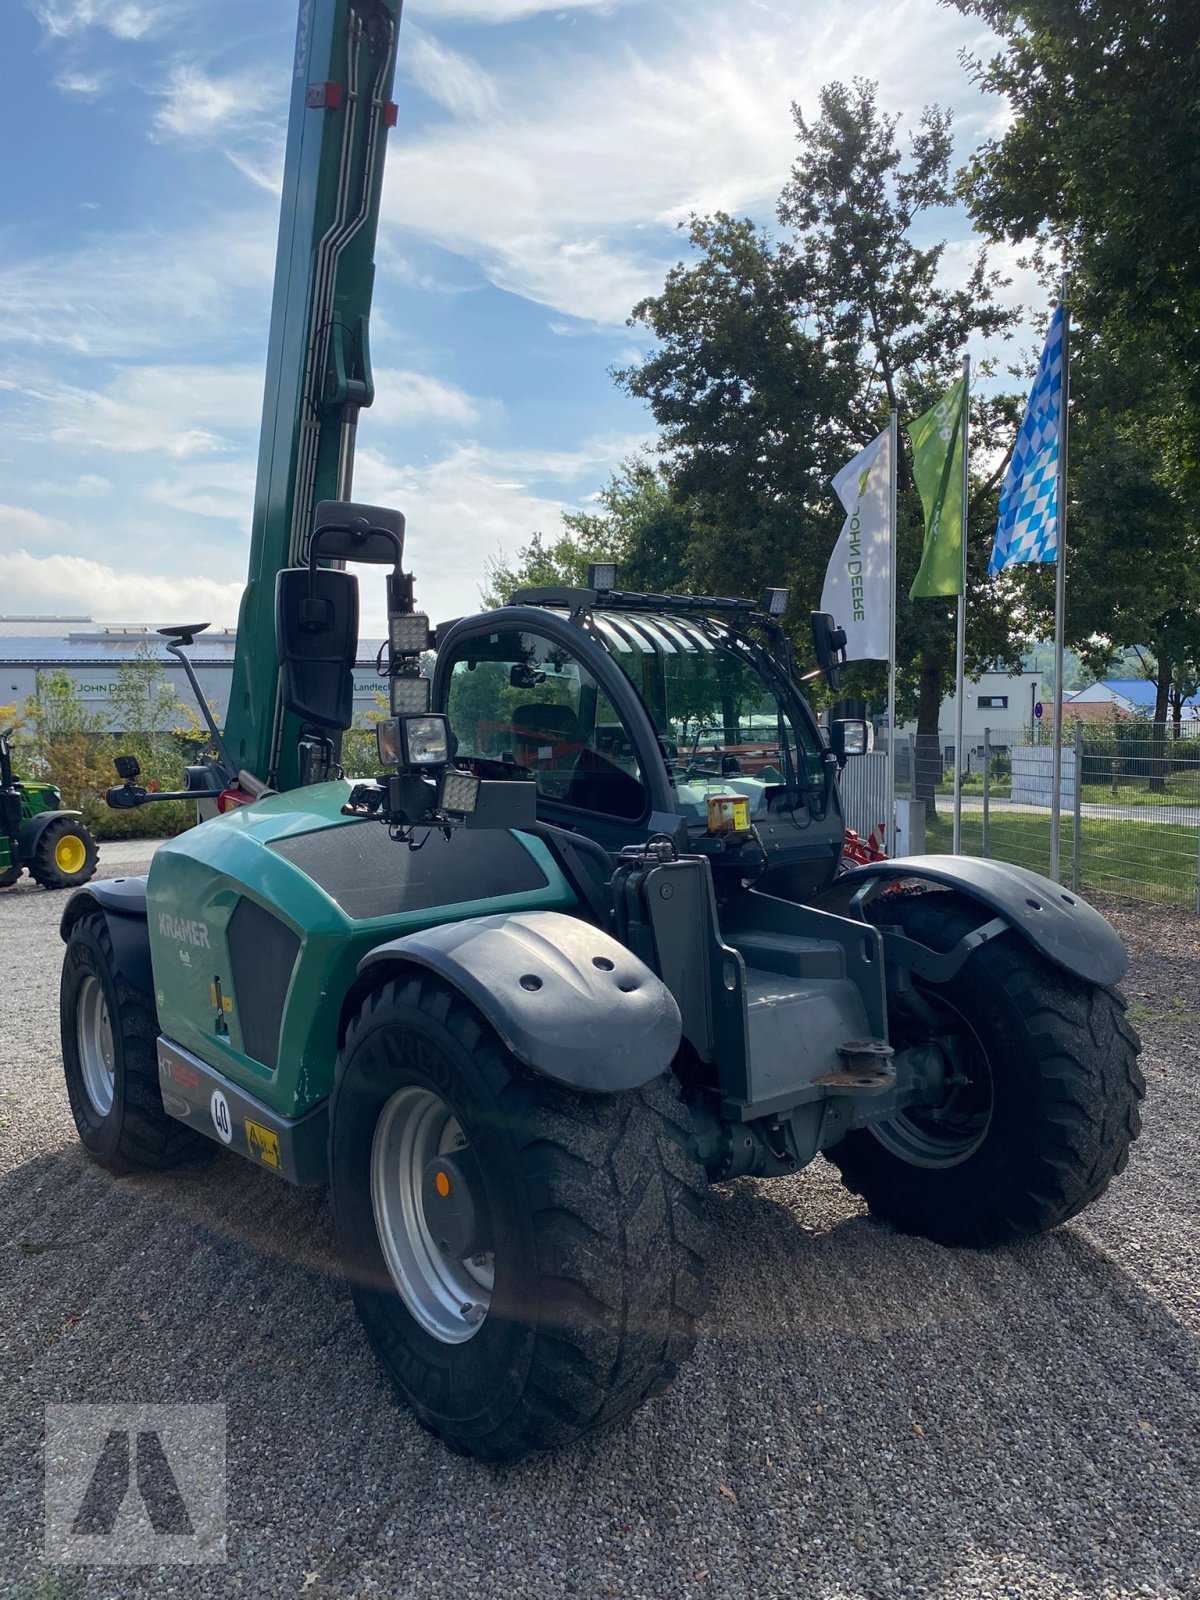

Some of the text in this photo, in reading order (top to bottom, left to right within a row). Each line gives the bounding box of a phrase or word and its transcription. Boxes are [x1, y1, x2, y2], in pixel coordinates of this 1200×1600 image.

[76, 683, 107, 693] JOHN
[158, 912, 212, 949] KRAMER
[215, 1097, 229, 1135] 40
